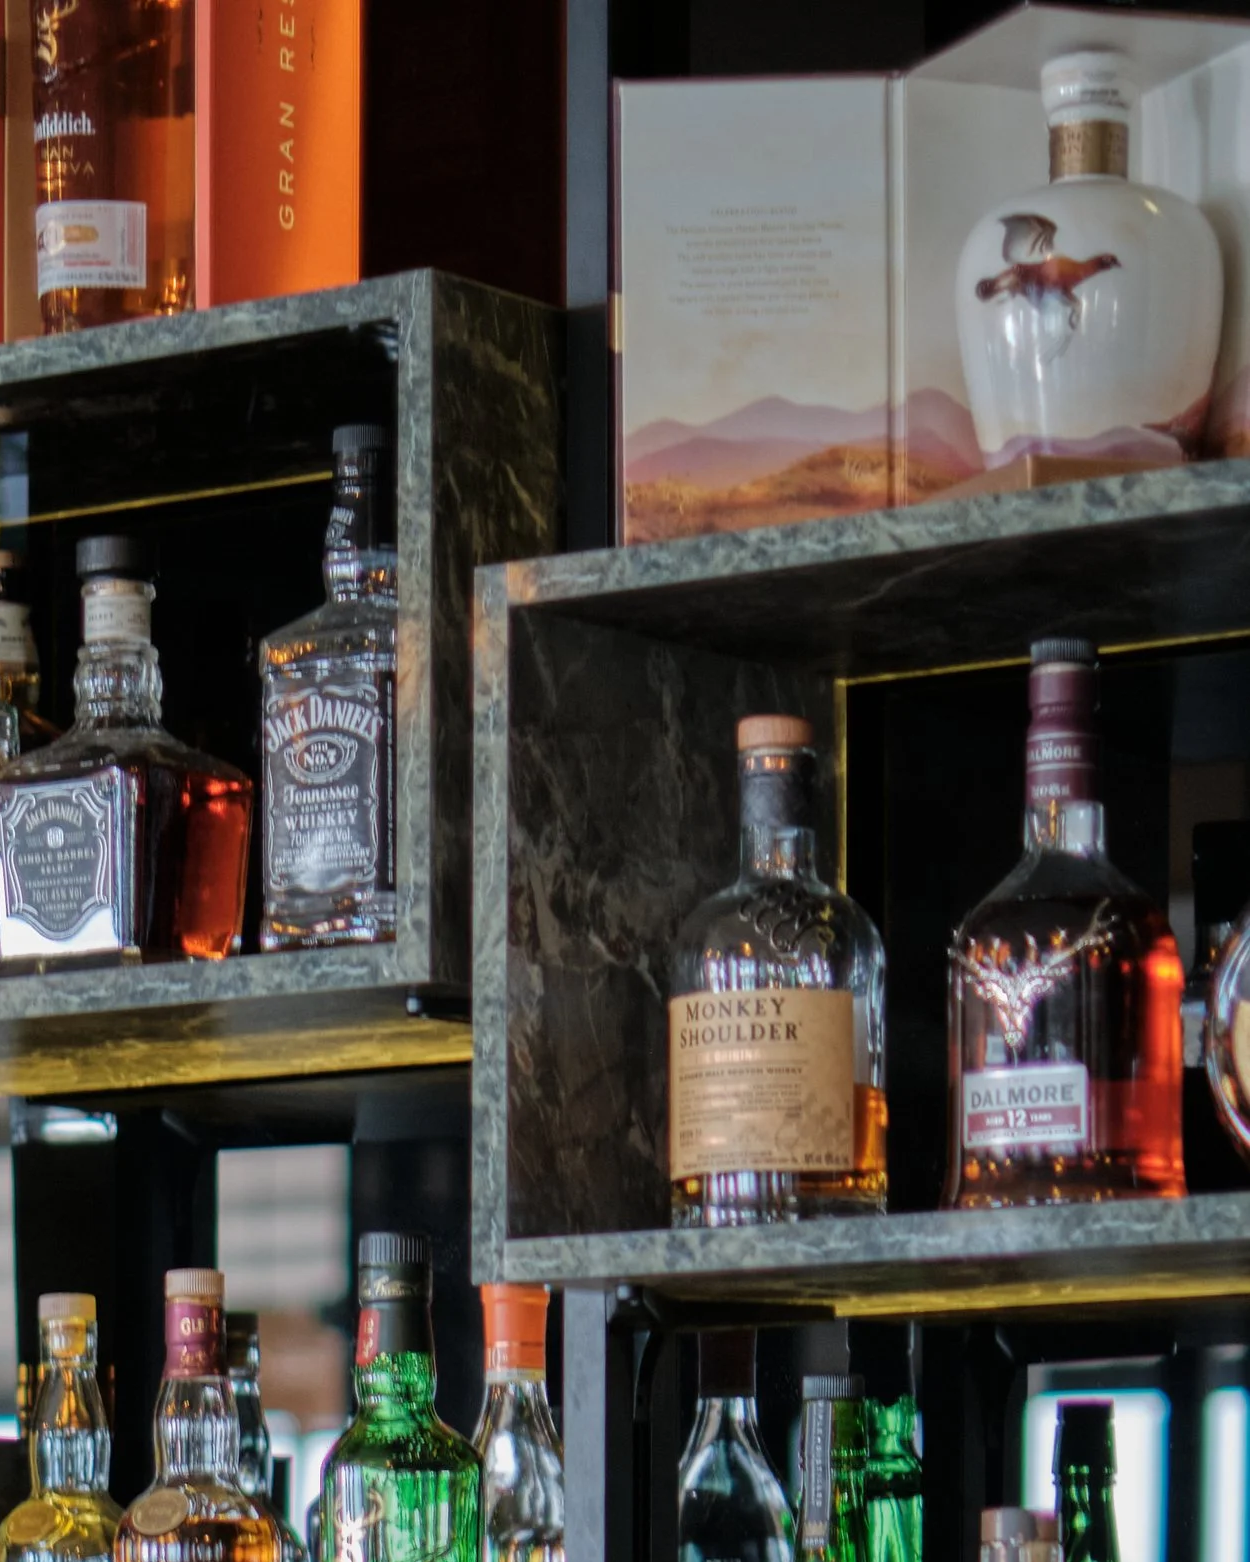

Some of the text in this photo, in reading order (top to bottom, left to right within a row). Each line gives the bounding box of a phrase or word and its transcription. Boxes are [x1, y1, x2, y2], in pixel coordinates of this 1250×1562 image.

[279, 101, 295, 230] GRAN
[266, 693, 385, 754] JACK DANIEL'S
[283, 783, 360, 807] Tennessee
[285, 808, 358, 833] WHISKEY
[685, 996, 786, 1024] MONKEY
[679, 1022, 800, 1050] SHOULDER
[970, 1082, 1075, 1109] DALMORE
[1007, 1107, 1027, 1128] 12
